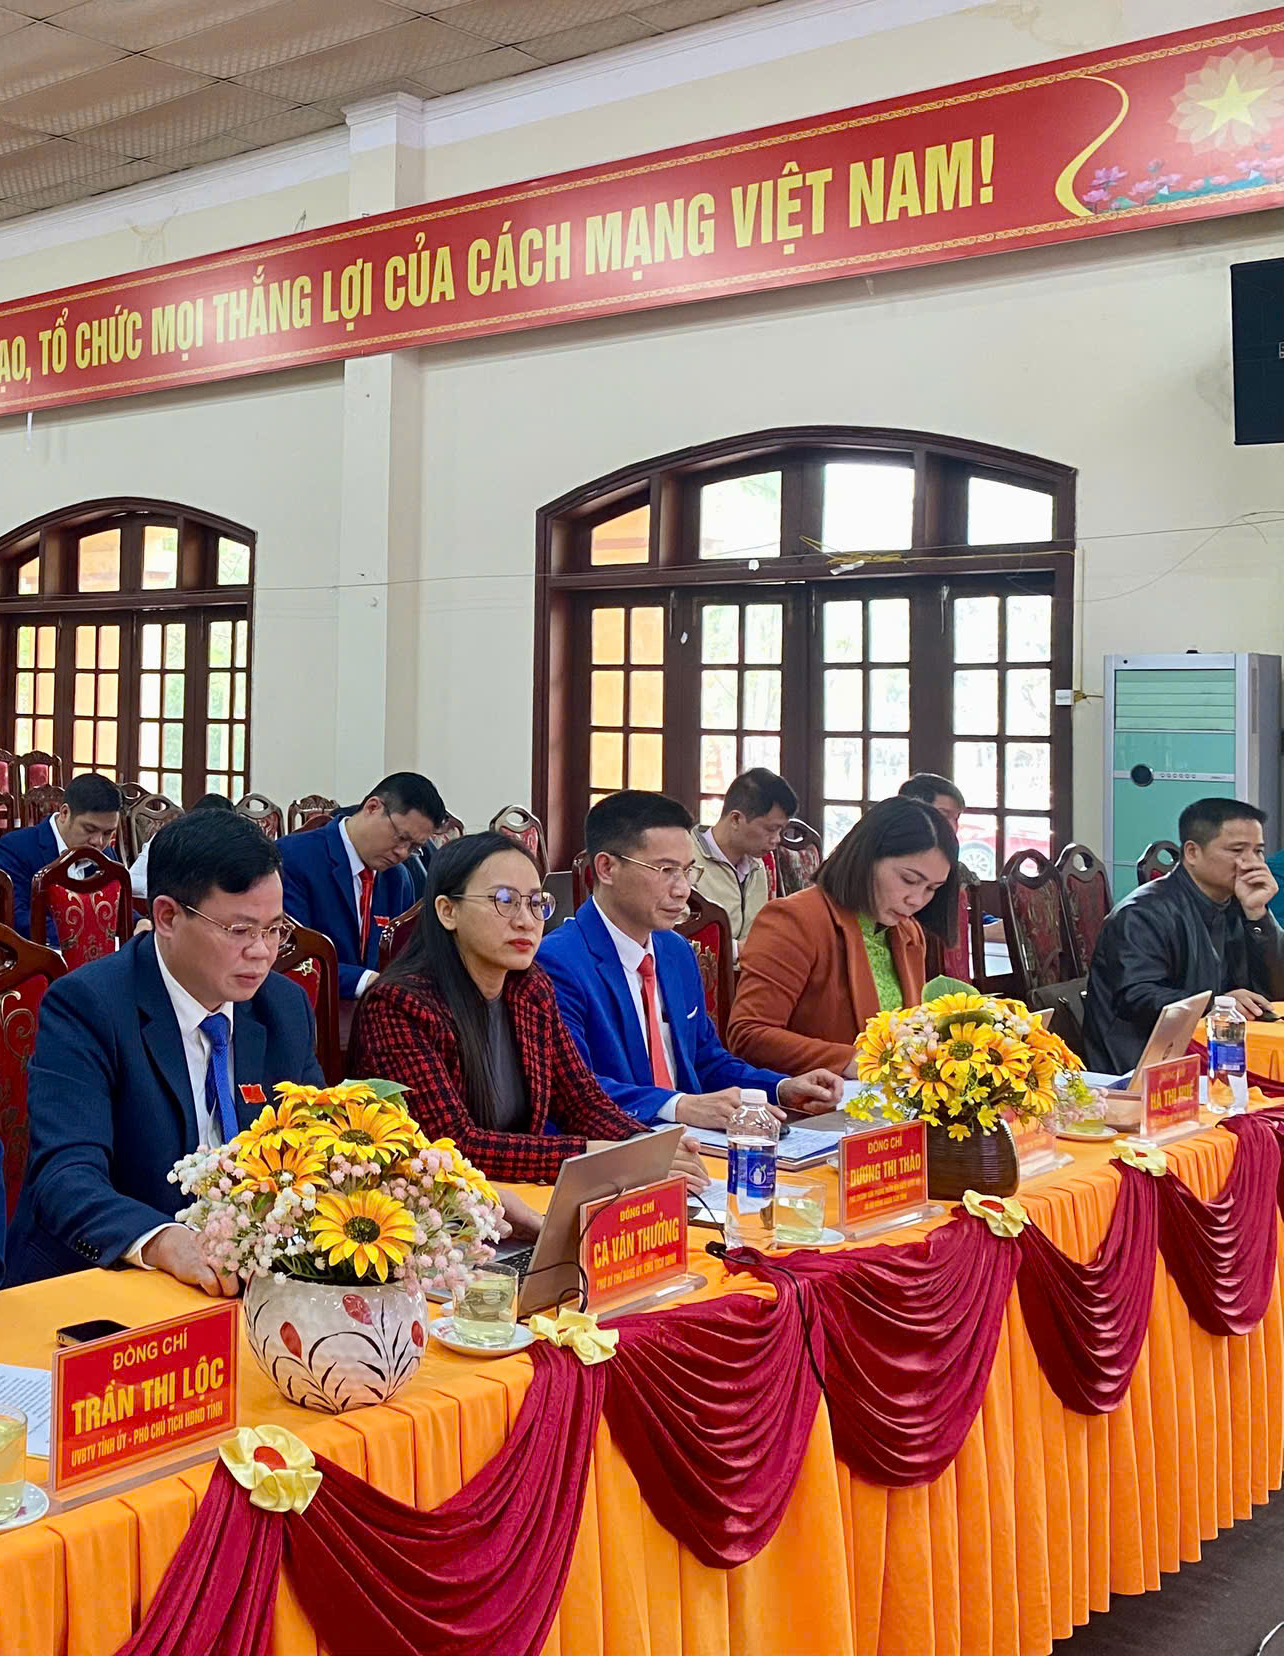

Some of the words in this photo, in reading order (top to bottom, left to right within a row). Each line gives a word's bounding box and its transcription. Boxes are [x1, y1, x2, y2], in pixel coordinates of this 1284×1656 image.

[39, 307, 69, 376] TỔ
[75, 304, 143, 370] CHỨC
[151, 297, 204, 362] MỌI
[213, 264, 312, 344] THẮNG
[322, 257, 373, 332] LỢI
[384, 231, 455, 311] CỦA
[467, 220, 570, 297] CÁCH
[584, 192, 716, 282] MẠNG
[731, 161, 834, 255] VIỆT
[848, 134, 995, 229] NAM!
[883, 1159, 898, 1180] THỊ
[612, 1228, 635, 1262] VĂN
[162, 1327, 188, 1355] CHÍ
[71, 1379, 134, 1436] TRẦN
[141, 1371, 176, 1411] THỊ
[182, 1355, 224, 1401] LỘC
[134, 1422, 149, 1445] PHÓ
[151, 1415, 165, 1438] CHỦ
[167, 1412, 183, 1436] TỊCH
